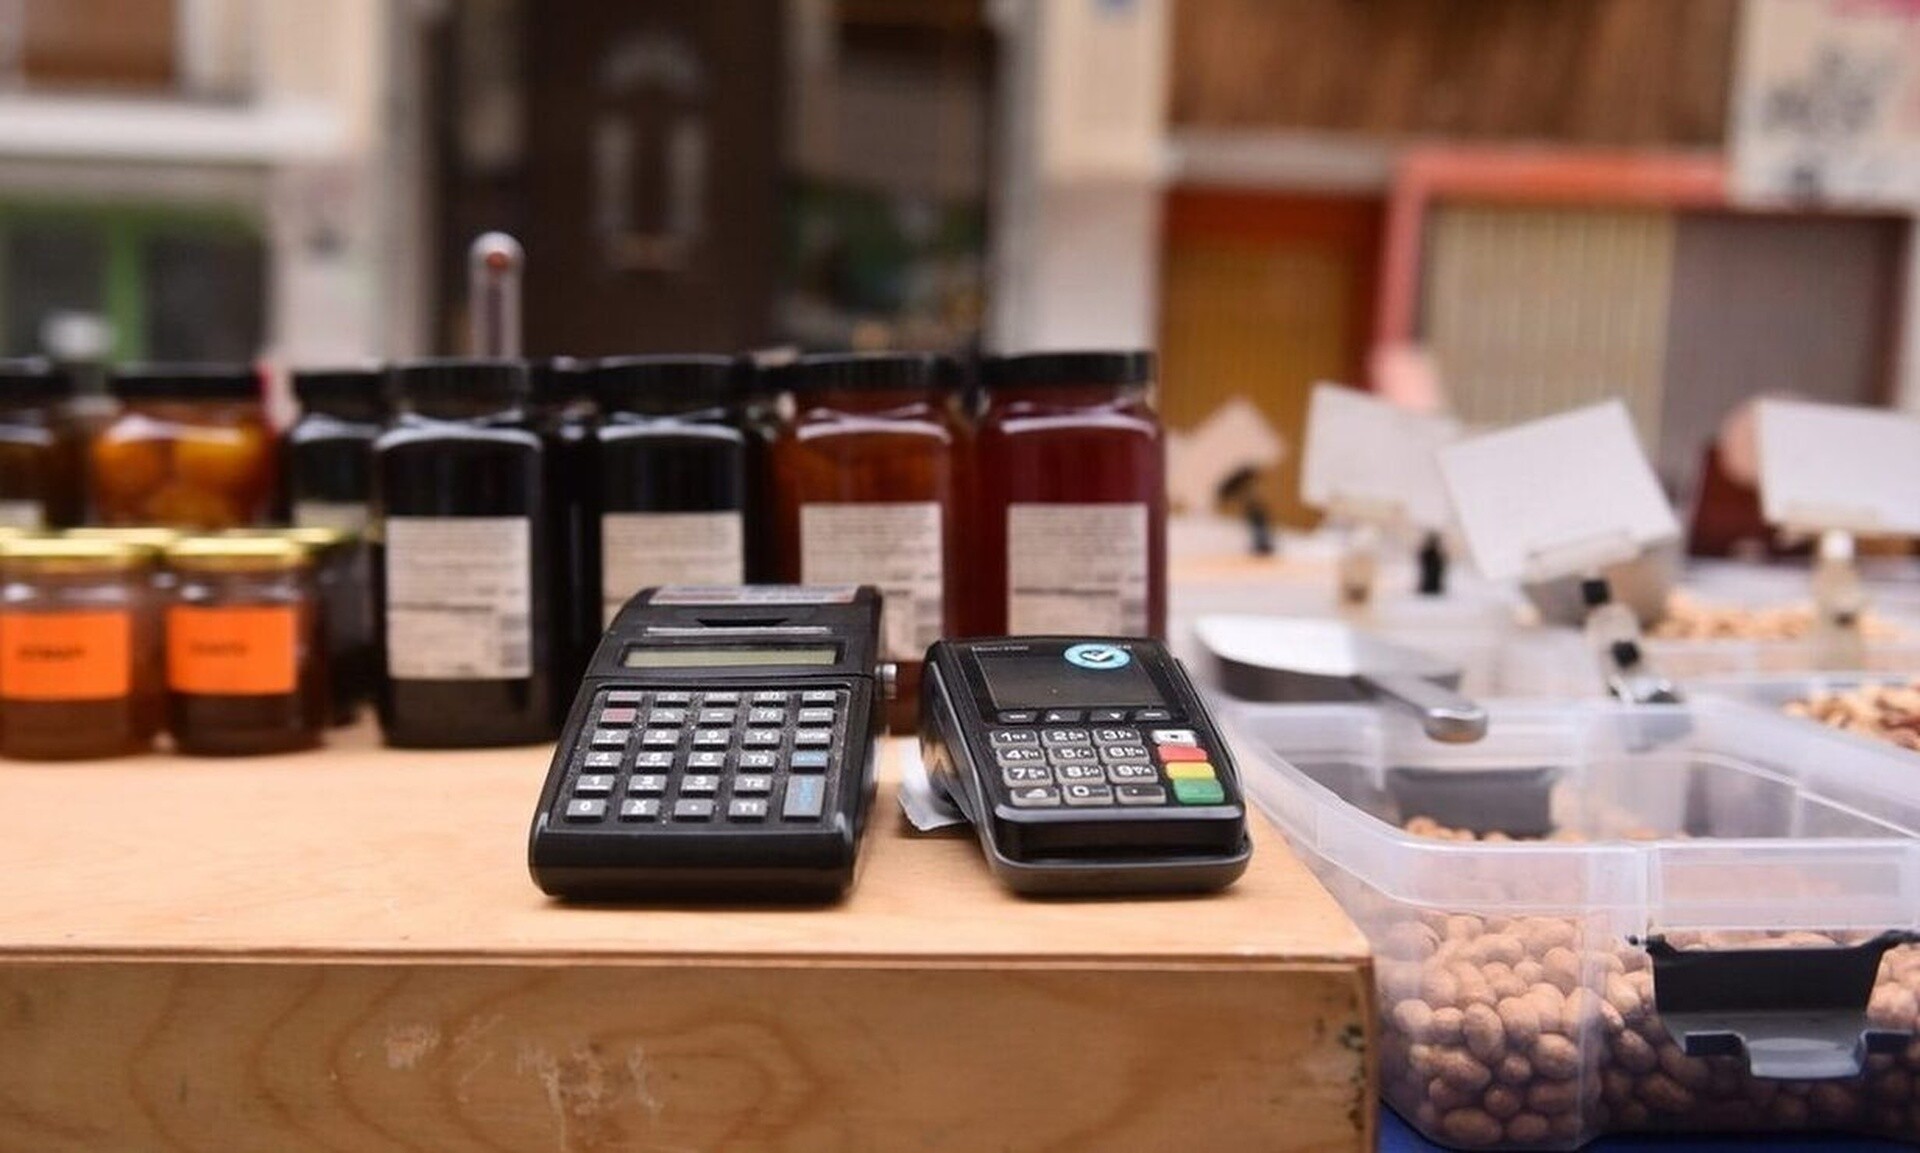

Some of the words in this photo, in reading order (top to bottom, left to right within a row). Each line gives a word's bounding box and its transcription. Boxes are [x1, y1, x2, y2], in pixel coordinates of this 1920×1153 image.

[606, 730, 617, 739] 7
[1001, 732, 1012, 741] 1
[1053, 731, 1067, 741] 2
[1104, 730, 1117, 739] 3
[596, 753, 609, 761] 4
[1006, 750, 1021, 759] 4
[1061, 749, 1075, 758] 5
[1110, 748, 1124, 757] 6
[1012, 768, 1026, 779] 7
[1066, 766, 1081, 777] 8
[1117, 764, 1132, 776] 9
[591, 776, 601, 785] 1
[744, 778, 764, 787] T2
[1072, 786, 1089, 797] 0
[580, 800, 592, 811] 0
[739, 802, 758, 811] T1
